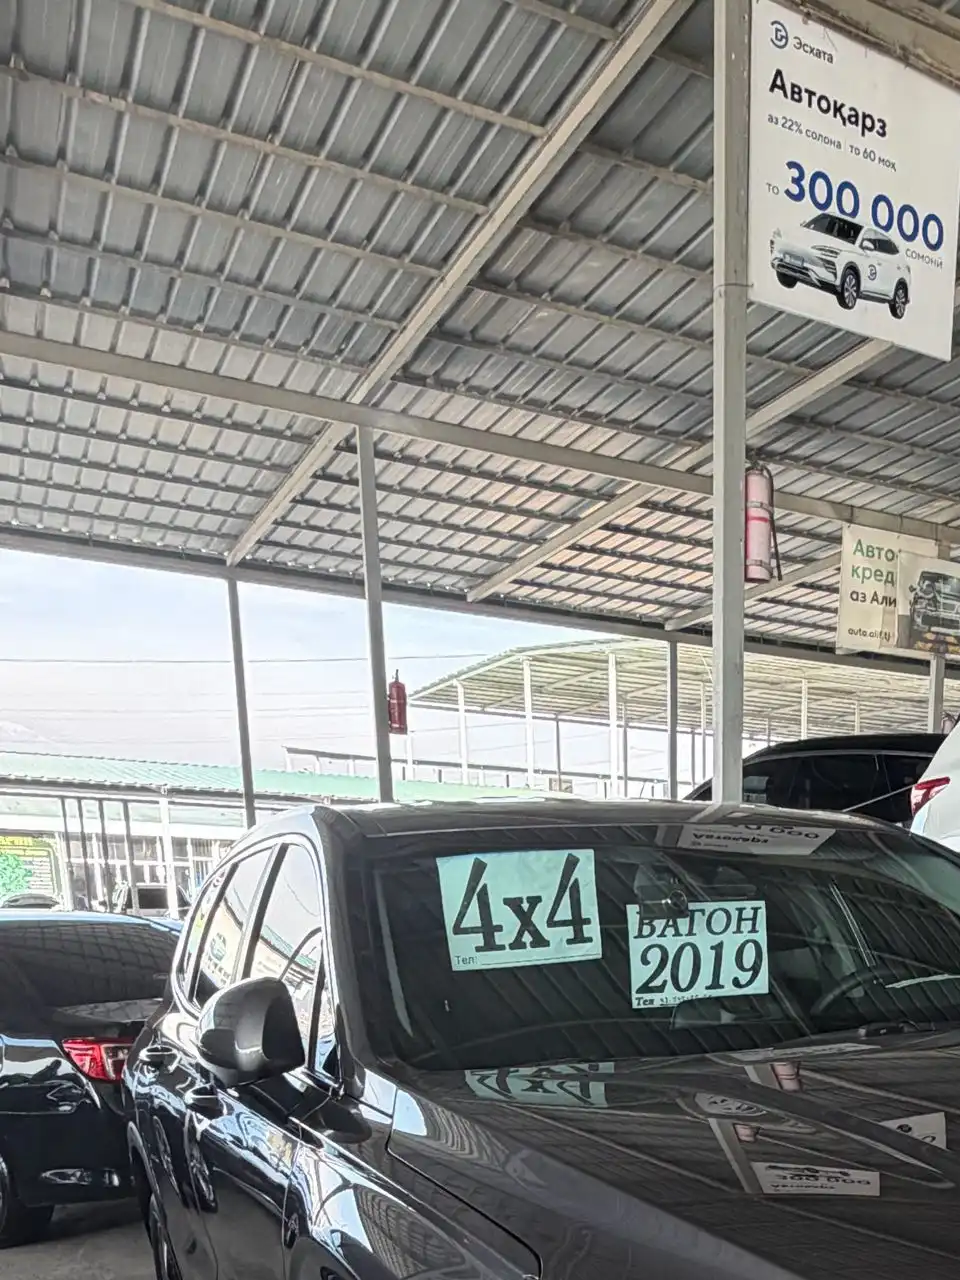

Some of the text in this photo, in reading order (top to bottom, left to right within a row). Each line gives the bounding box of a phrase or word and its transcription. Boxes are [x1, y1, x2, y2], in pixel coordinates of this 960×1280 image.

[793, 36, 834, 64] Эсхата
[769, 68, 887, 138] Автоқарз
[767, 114, 779, 125] аз
[781, 116, 803, 134] 22%
[849, 145, 860, 156] то
[863, 148, 876, 162] 60
[784, 160, 860, 219] 300
[871, 194, 944, 251] 000
[851, 564, 897, 587] кред
[849, 590, 867, 603] аз
[633, 906, 762, 939] ВАГОН
[635, 939, 763, 995] 2019
